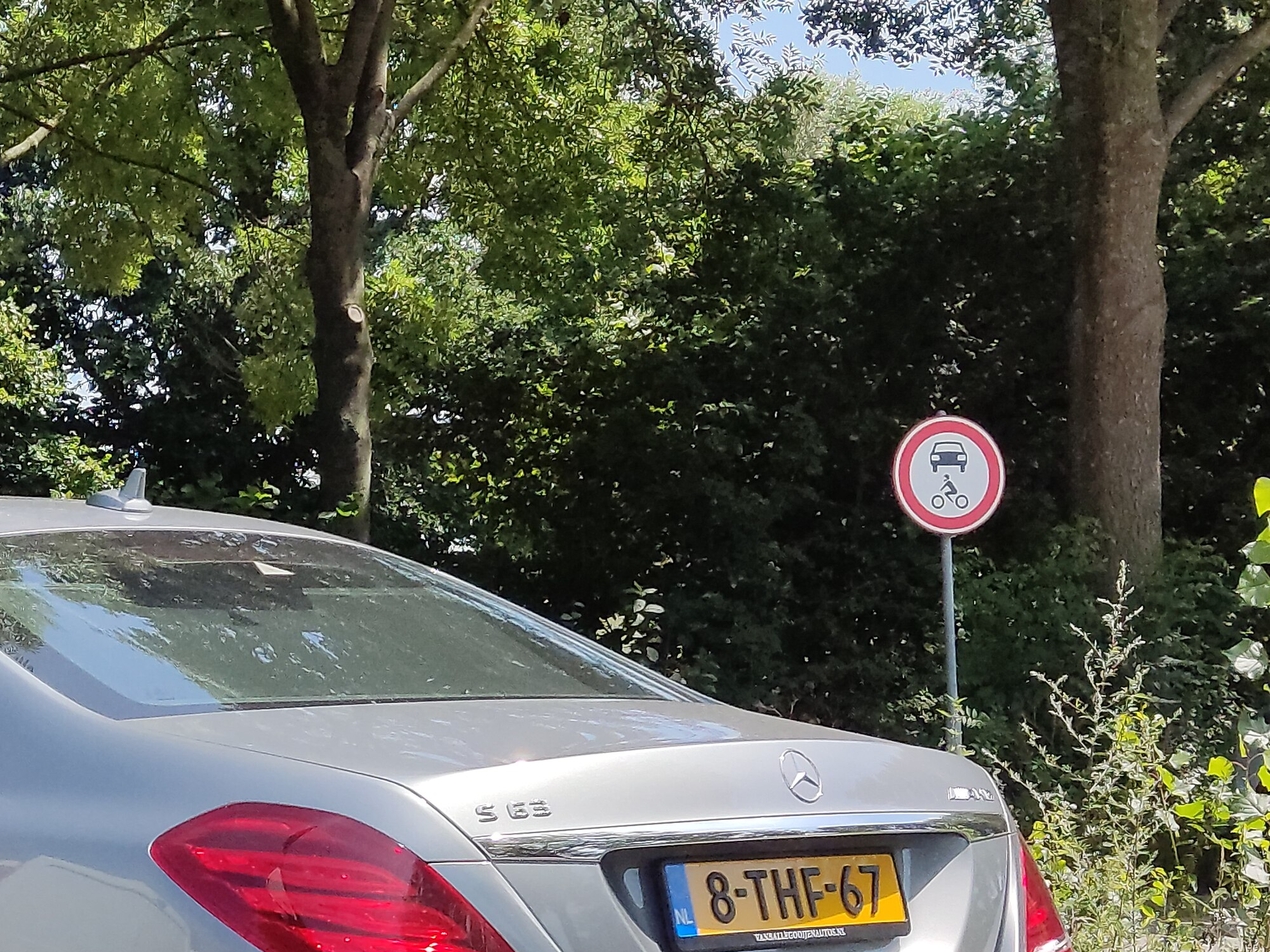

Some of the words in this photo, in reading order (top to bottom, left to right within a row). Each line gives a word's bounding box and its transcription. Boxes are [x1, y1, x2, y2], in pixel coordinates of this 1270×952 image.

[475, 804, 498, 823] S
[506, 799, 552, 820] 63
[706, 865, 880, 924] 8-THF-67
[674, 908, 693, 925] NL
